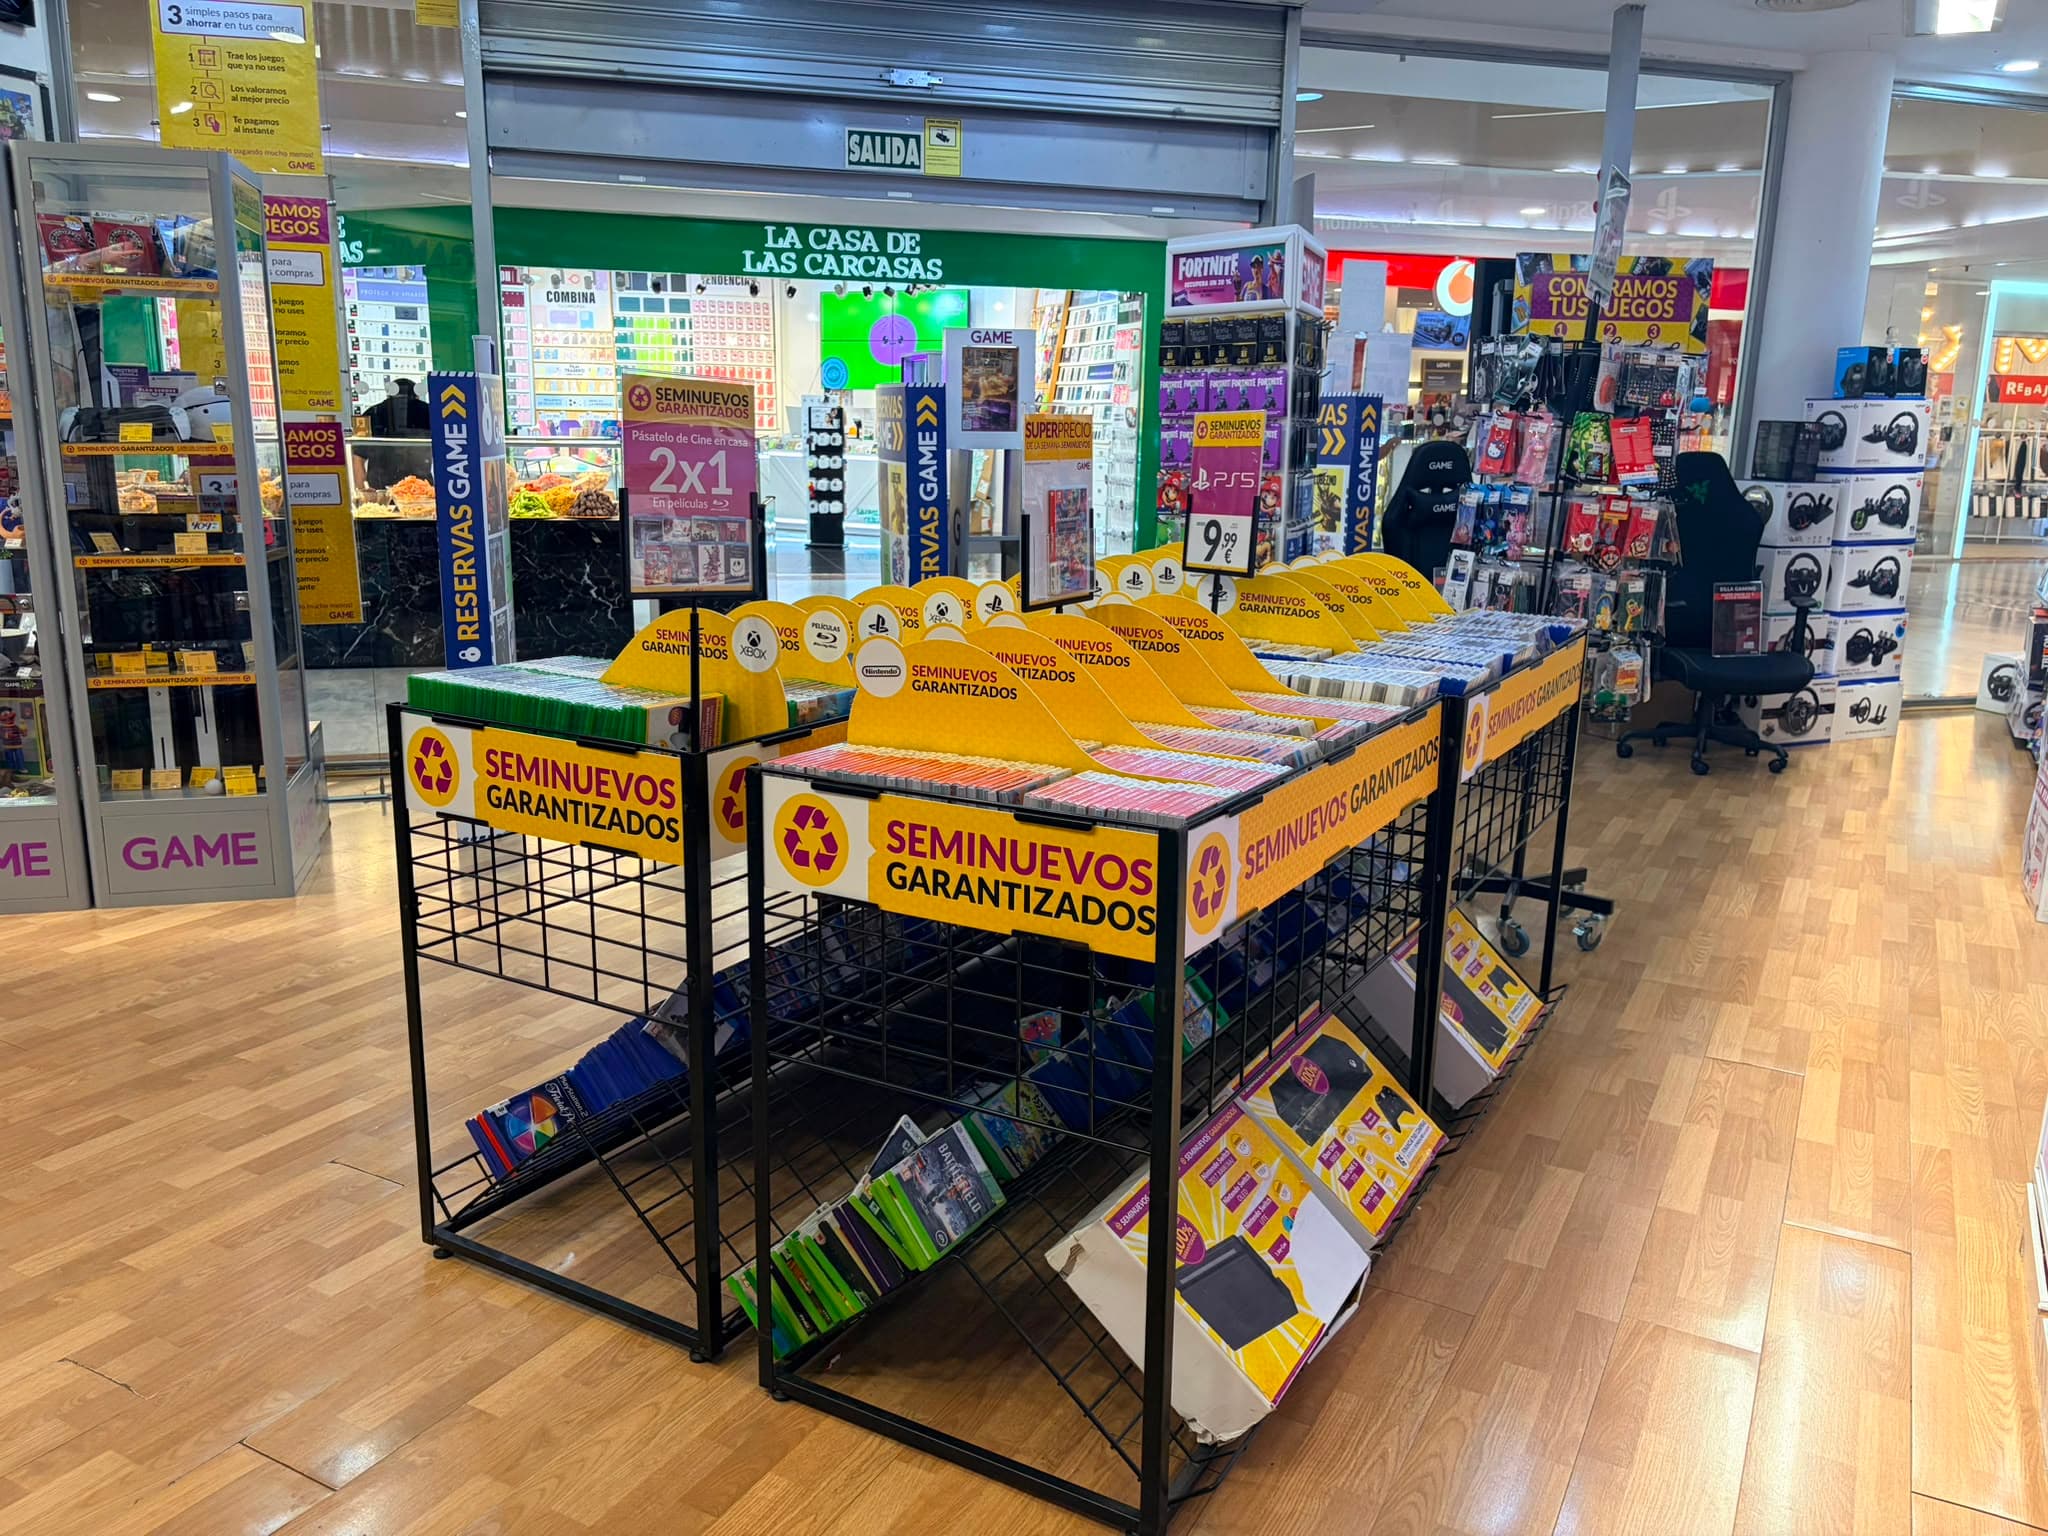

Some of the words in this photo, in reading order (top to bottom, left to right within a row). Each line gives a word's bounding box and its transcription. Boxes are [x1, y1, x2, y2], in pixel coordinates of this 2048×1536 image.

[168, 5, 182, 25] 3
[185, 7, 221, 19] simples
[223, 10, 250, 22] pasos
[252, 13, 273, 23] para
[186, 18, 222, 29] ahorrar
[224, 21, 237, 30] en
[239, 22, 253, 31] tus
[255, 24, 296, 35] compras
[188, 53, 195, 62] 1
[226, 52, 244, 61] Trae
[246, 53, 258, 62] los
[259, 53, 286, 64] juegos
[227, 63, 243, 71] que
[244, 63, 254, 73] ya
[190, 86, 197, 95] 2
[230, 85, 244, 93] Los
[246, 86, 287, 95] valoramos
[231, 94, 239, 102] al
[240, 95, 263, 104] mejor
[265, 96, 290, 105] precio
[193, 118, 200, 127] 3
[233, 116, 242, 125] Te
[244, 118, 279, 128] pagamos
[242, 126, 275, 135] instante
[849, 134, 920, 166] SALIDA
[288, 161, 315, 170] GAME
[264, 203, 321, 219] RAMOS
[764, 226, 802, 249] LA
[808, 229, 879, 253] CASA
[887, 232, 921, 255] DE
[271, 258, 292, 267] para
[742, 250, 797, 273] LAS
[804, 253, 942, 279] CARCASAS
[1179, 253, 1239, 280] FORTNITE
[61, 275, 105, 285] SEMINUEVOS
[105, 278, 160, 287] GARANTIZADOS
[275, 269, 314, 279] compras
[278, 299, 304, 308] juegos
[546, 291, 595, 304] COMBINA
[1549, 297, 1589, 316] TUS
[1603, 298, 1675, 319] UEGOS
[275, 329, 306, 337] loramos
[970, 330, 1013, 344] GAME
[1557, 324, 1564, 336] 1
[1606, 325, 1614, 337] 2
[1650, 328, 1658, 338] 3
[285, 339, 310, 347] precio
[214, 360, 221, 368] 3
[308, 399, 335, 407] GAME
[655, 387, 749, 408] SEMINUEVOS
[656, 401, 750, 419] GARANTIZADOS
[1025, 422, 1091, 438] SUPERPRECIO
[1210, 419, 1261, 431] SEMINUEVOS
[632, 430, 674, 444] Pásatelo
[676, 431, 688, 443] de
[691, 434, 712, 446] Cine
[714, 438, 726, 446] en
[728, 438, 748, 448] casa
[1209, 429, 1261, 440] GARANTIZADOS
[1061, 440, 1090, 449] SEMINUEVOS
[444, 423, 472, 500] GAME
[917, 431, 939, 502] GAME
[1077, 462, 1090, 470] GAME
[1357, 437, 1375, 501] GAME
[1428, 461, 1453, 470] GAME
[649, 447, 733, 496] 2x1
[289, 481, 310, 490] para
[1213, 471, 1256, 488] PS5
[294, 491, 331, 501] compras
[653, 496, 665, 508] En
[666, 497, 708, 511] películas
[1433, 503, 1456, 512] GAME
[298, 518, 323, 527] juegos
[135, 557, 189, 565] GARANTIZADOS
[305, 554, 329, 563] precio
[1224, 548, 1232, 564] €
[449, 503, 480, 641] RESERVAS
[1240, 592, 1306, 608] SEMINUEVOS
[329, 611, 355, 620] GAME
[1239, 602, 1320, 619] GARANTIZADOS
[811, 622, 841, 633] PELÍCULAS
[1106, 626, 1164, 640] MINUEVOS
[1180, 627, 1224, 641] TIZADOS
[656, 628, 727, 647] SEMINEVOS
[642, 641, 729, 660] GARANTIADOS
[1050, 638, 1113, 653] MINUEVOS
[1128, 639, 1180, 654] NTIZADOS
[740, 647, 767, 660] XBOX
[991, 652, 1057, 667] MINUEVOS
[1070, 653, 1131, 667] NTIZADOS
[865, 668, 897, 676] Nintendo
[912, 664, 997, 683] SEMINUEVOS
[1008, 668, 1076, 683] NTIZADOS
[103, 678, 145, 686] SEMINUEVOS
[146, 676, 199, 684] GARANTIZADOS
[912, 679, 1018, 700] GARANTIZADOS
[1487, 695, 1535, 739] SEMINUEVOS
[1536, 660, 1582, 702] GARANTIZADOS
[486, 748, 676, 810] SEMINUEVOS
[486, 785, 680, 843] GARANTIZADOS
[1244, 792, 1347, 880] SEMINUEVOS
[1350, 735, 1440, 814] GARANTIZADOS
[122, 832, 258, 871] GAME
[886, 820, 1153, 896] SEMINUEVOS
[886, 861, 1156, 935] GARANTIZADOS
[543, 1080, 571, 1113] Trivial
[1183, 1132, 1211, 1162] SEMINUEVOS
[1206, 1104, 1237, 1137] GARANTIZADOS
[1200, 1160, 1220, 1181] Nintendo
[1214, 1147, 1231, 1165] Switch
[934, 1142, 985, 1213] BATTLEFIELD
[1220, 1185, 1239, 1205] Nintendo
[1235, 1171, 1252, 1189] Switch
[1119, 1194, 1150, 1228] SEMINUEVOS
[1241, 1208, 1260, 1229] Nintendo
[1256, 1195, 1273, 1213] Switch
